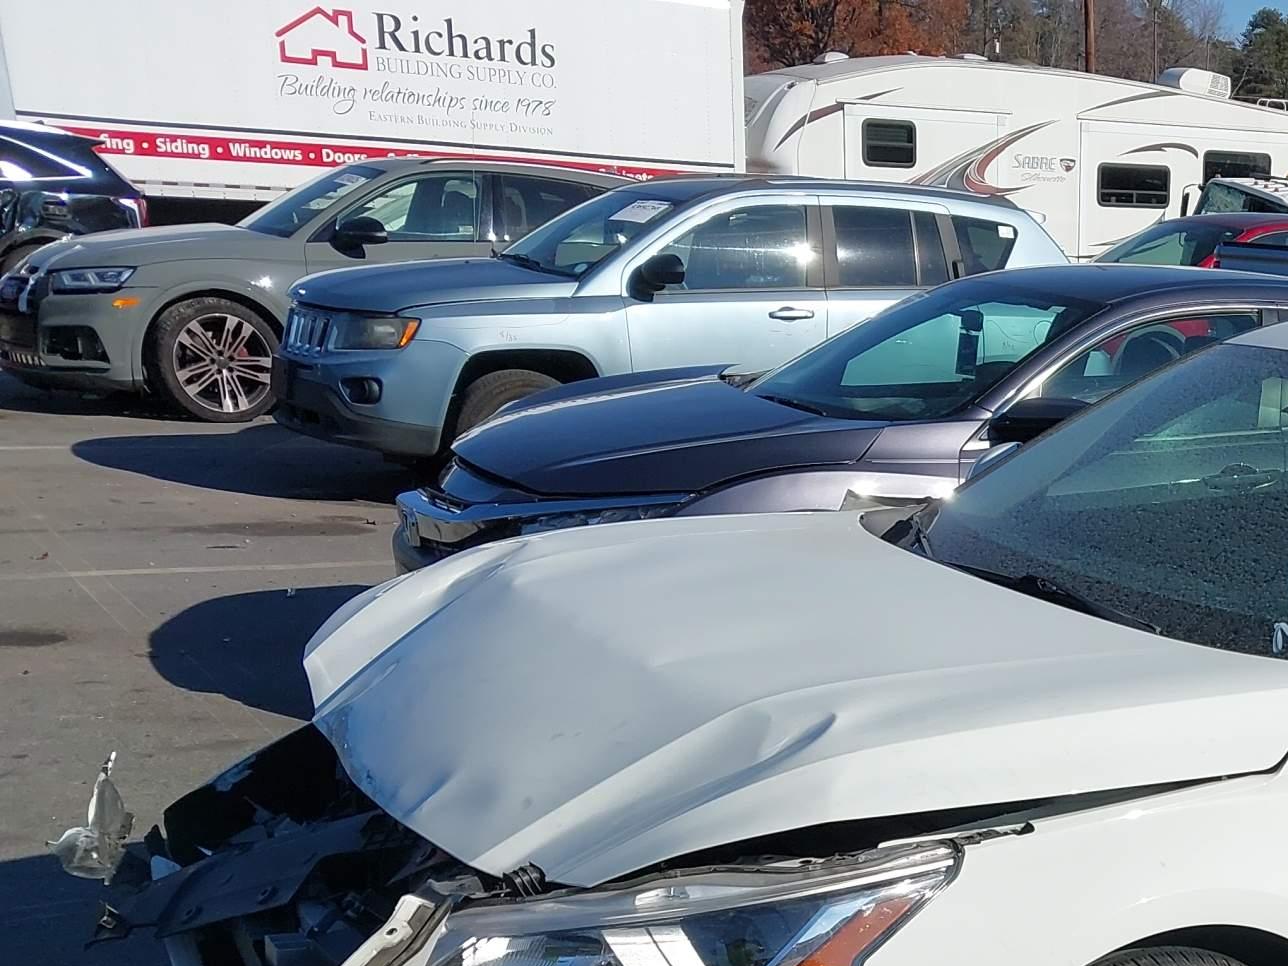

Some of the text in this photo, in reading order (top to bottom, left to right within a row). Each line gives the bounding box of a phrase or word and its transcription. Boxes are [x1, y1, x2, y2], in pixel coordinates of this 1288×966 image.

[372, 12, 556, 68] Richards
[376, 57, 557, 89] BUILDING SUPPLY CO.
[277, 73, 556, 117] Building relationships since 1978
[155, 138, 210, 158] Siding
[229, 143, 303, 161] Windows
[321, 148, 367, 163] Doors
[1012, 153, 1057, 170] SABRE
